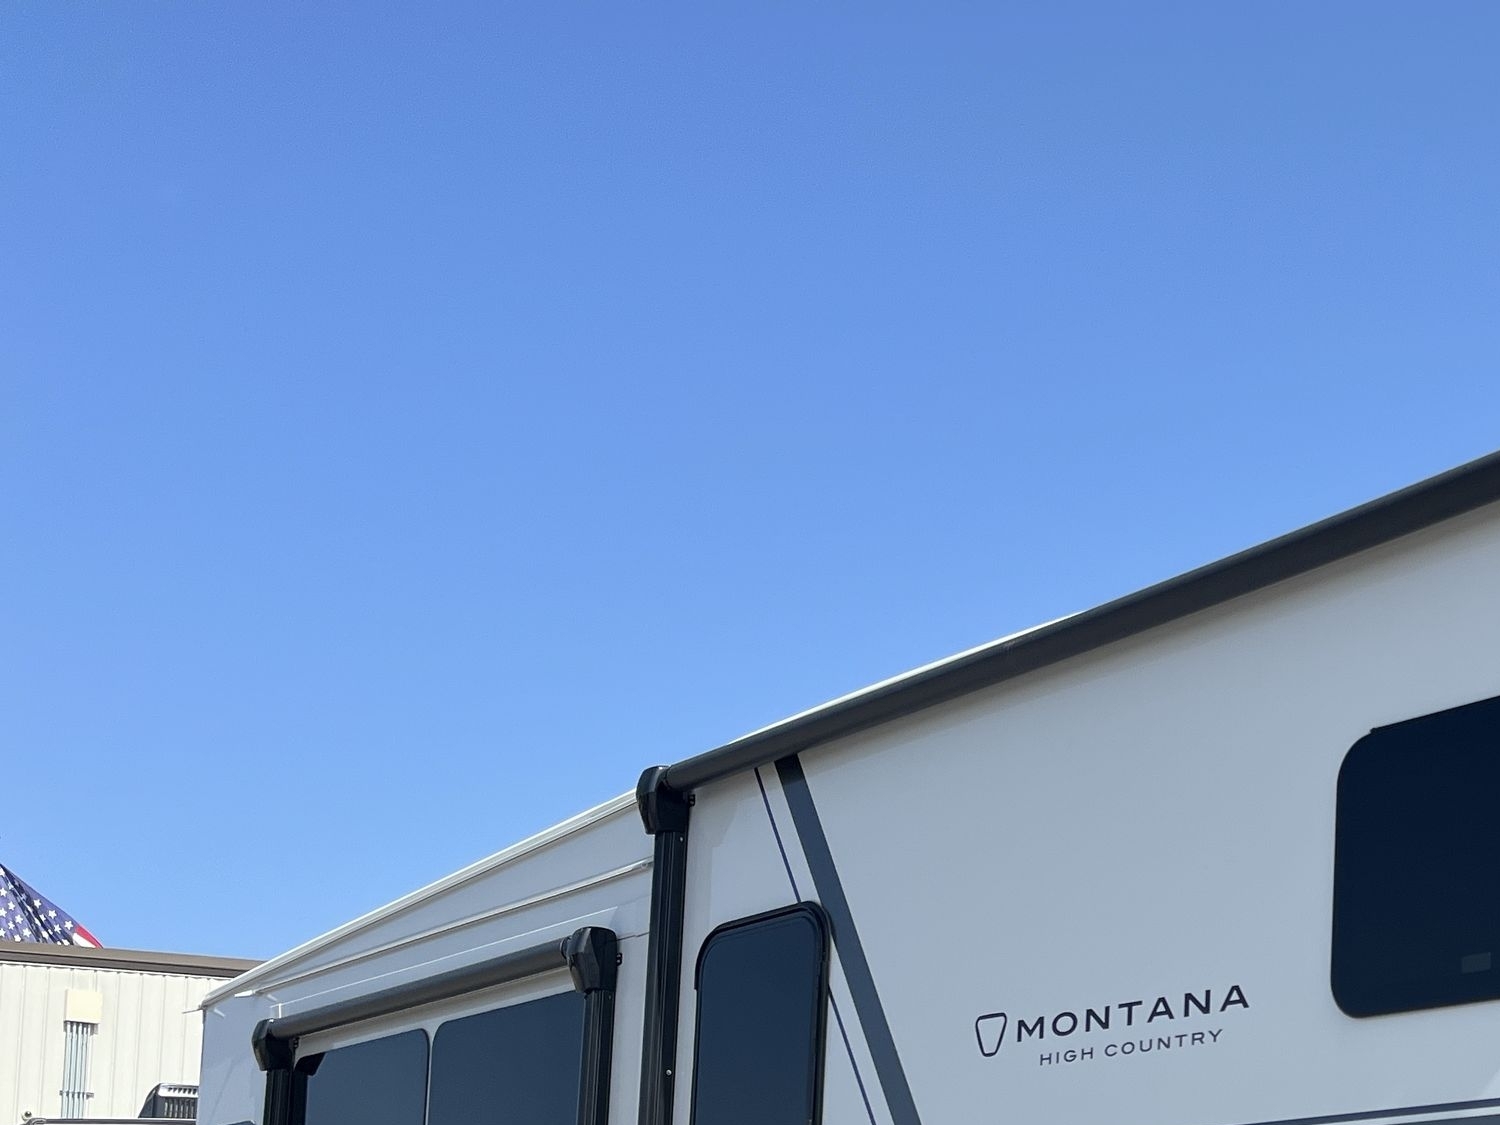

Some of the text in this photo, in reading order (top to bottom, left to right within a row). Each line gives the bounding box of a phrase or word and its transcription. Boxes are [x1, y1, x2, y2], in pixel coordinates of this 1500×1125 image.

[1016, 985, 1250, 1043] MONTANA
[1039, 1028, 1224, 1066] HIGH COUNTRY
